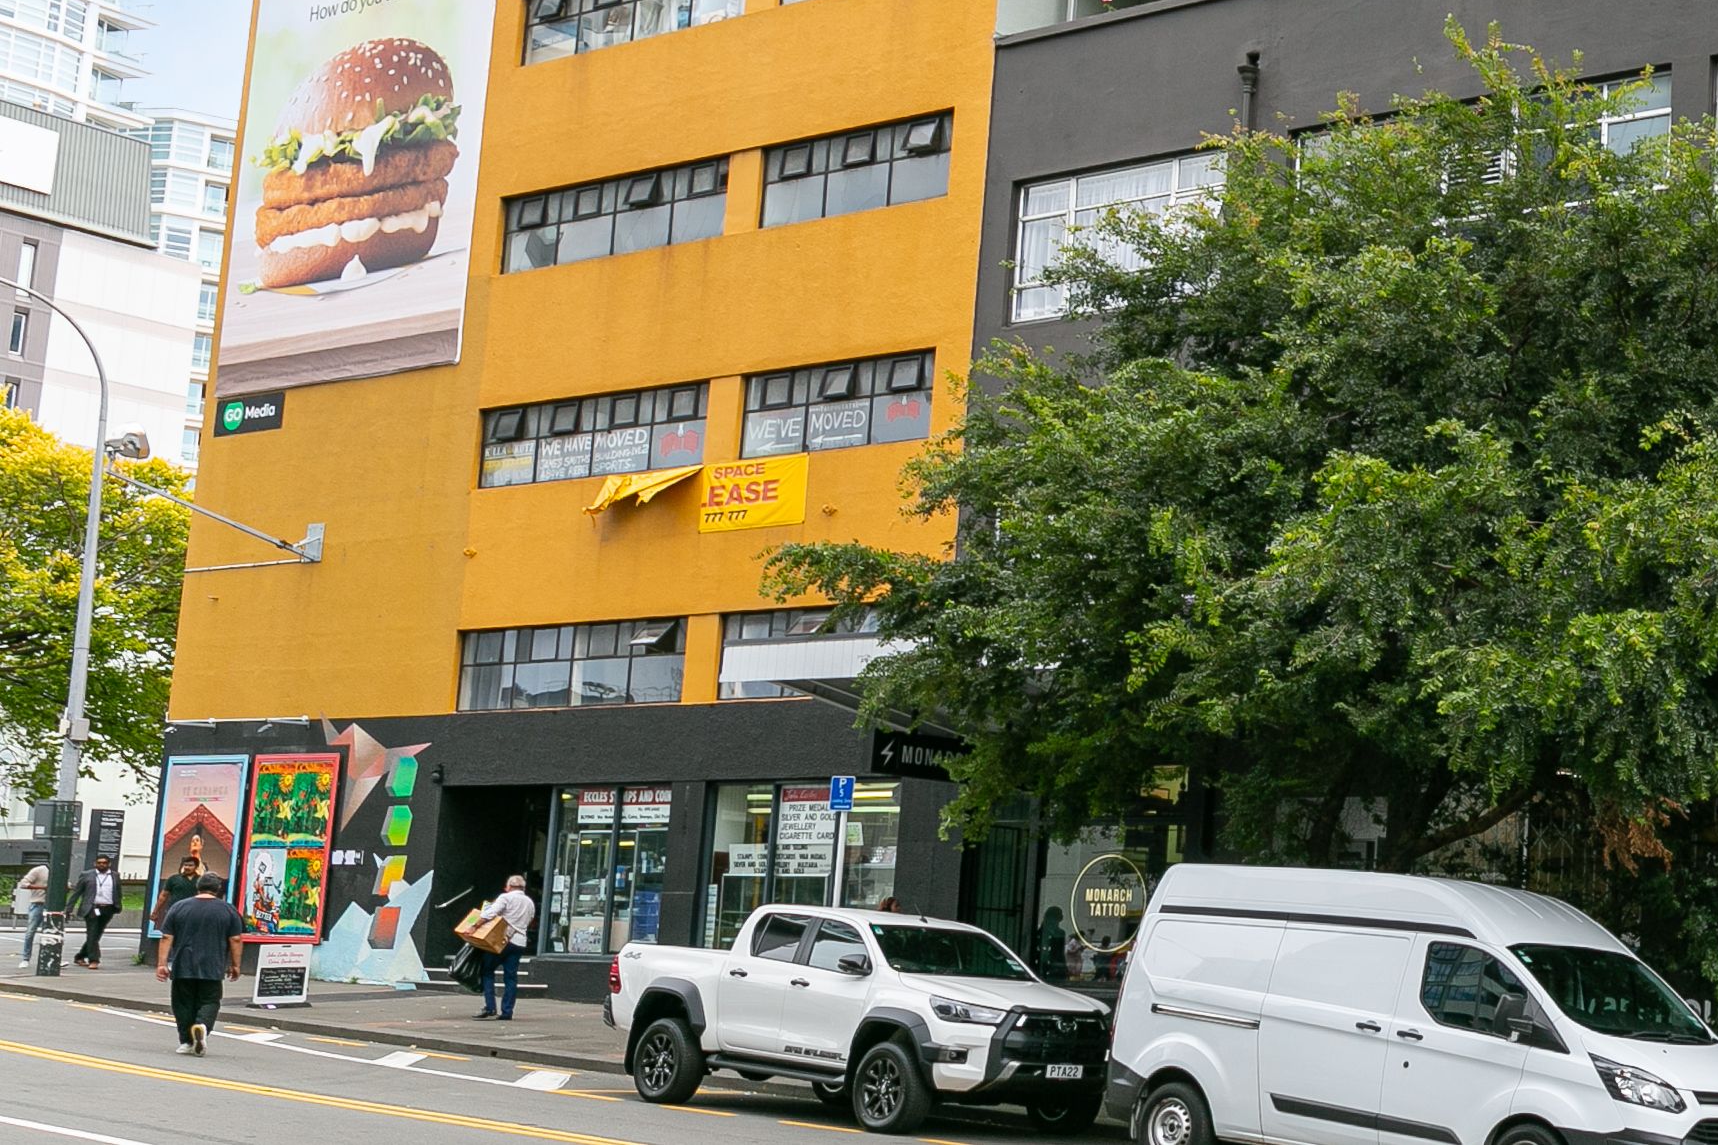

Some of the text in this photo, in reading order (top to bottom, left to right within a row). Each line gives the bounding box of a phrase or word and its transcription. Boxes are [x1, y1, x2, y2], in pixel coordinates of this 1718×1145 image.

[309, 2, 339, 22] How
[225, 403, 276, 422] GO Media
[748, 409, 866, 441] WE'VE MOVED
[541, 428, 648, 457] WE HAVE MOVED
[713, 462, 767, 480] SPACE
[701, 478, 780, 509] EASE
[704, 509, 748, 523] 777 777
[839, 778, 847, 789] P
[583, 791, 608, 803] ECCLES
[638, 790, 654, 802] AND
[804, 813, 818, 821] AND
[820, 813, 837, 821] GOLD
[781, 823, 816, 831] JEWELLERY
[780, 832, 813, 840] CIGARETTE
[1085, 888, 1133, 902] MONARCH
[1090, 903, 1127, 917] TATTOO
[1049, 1065, 1079, 1078] PTA22
